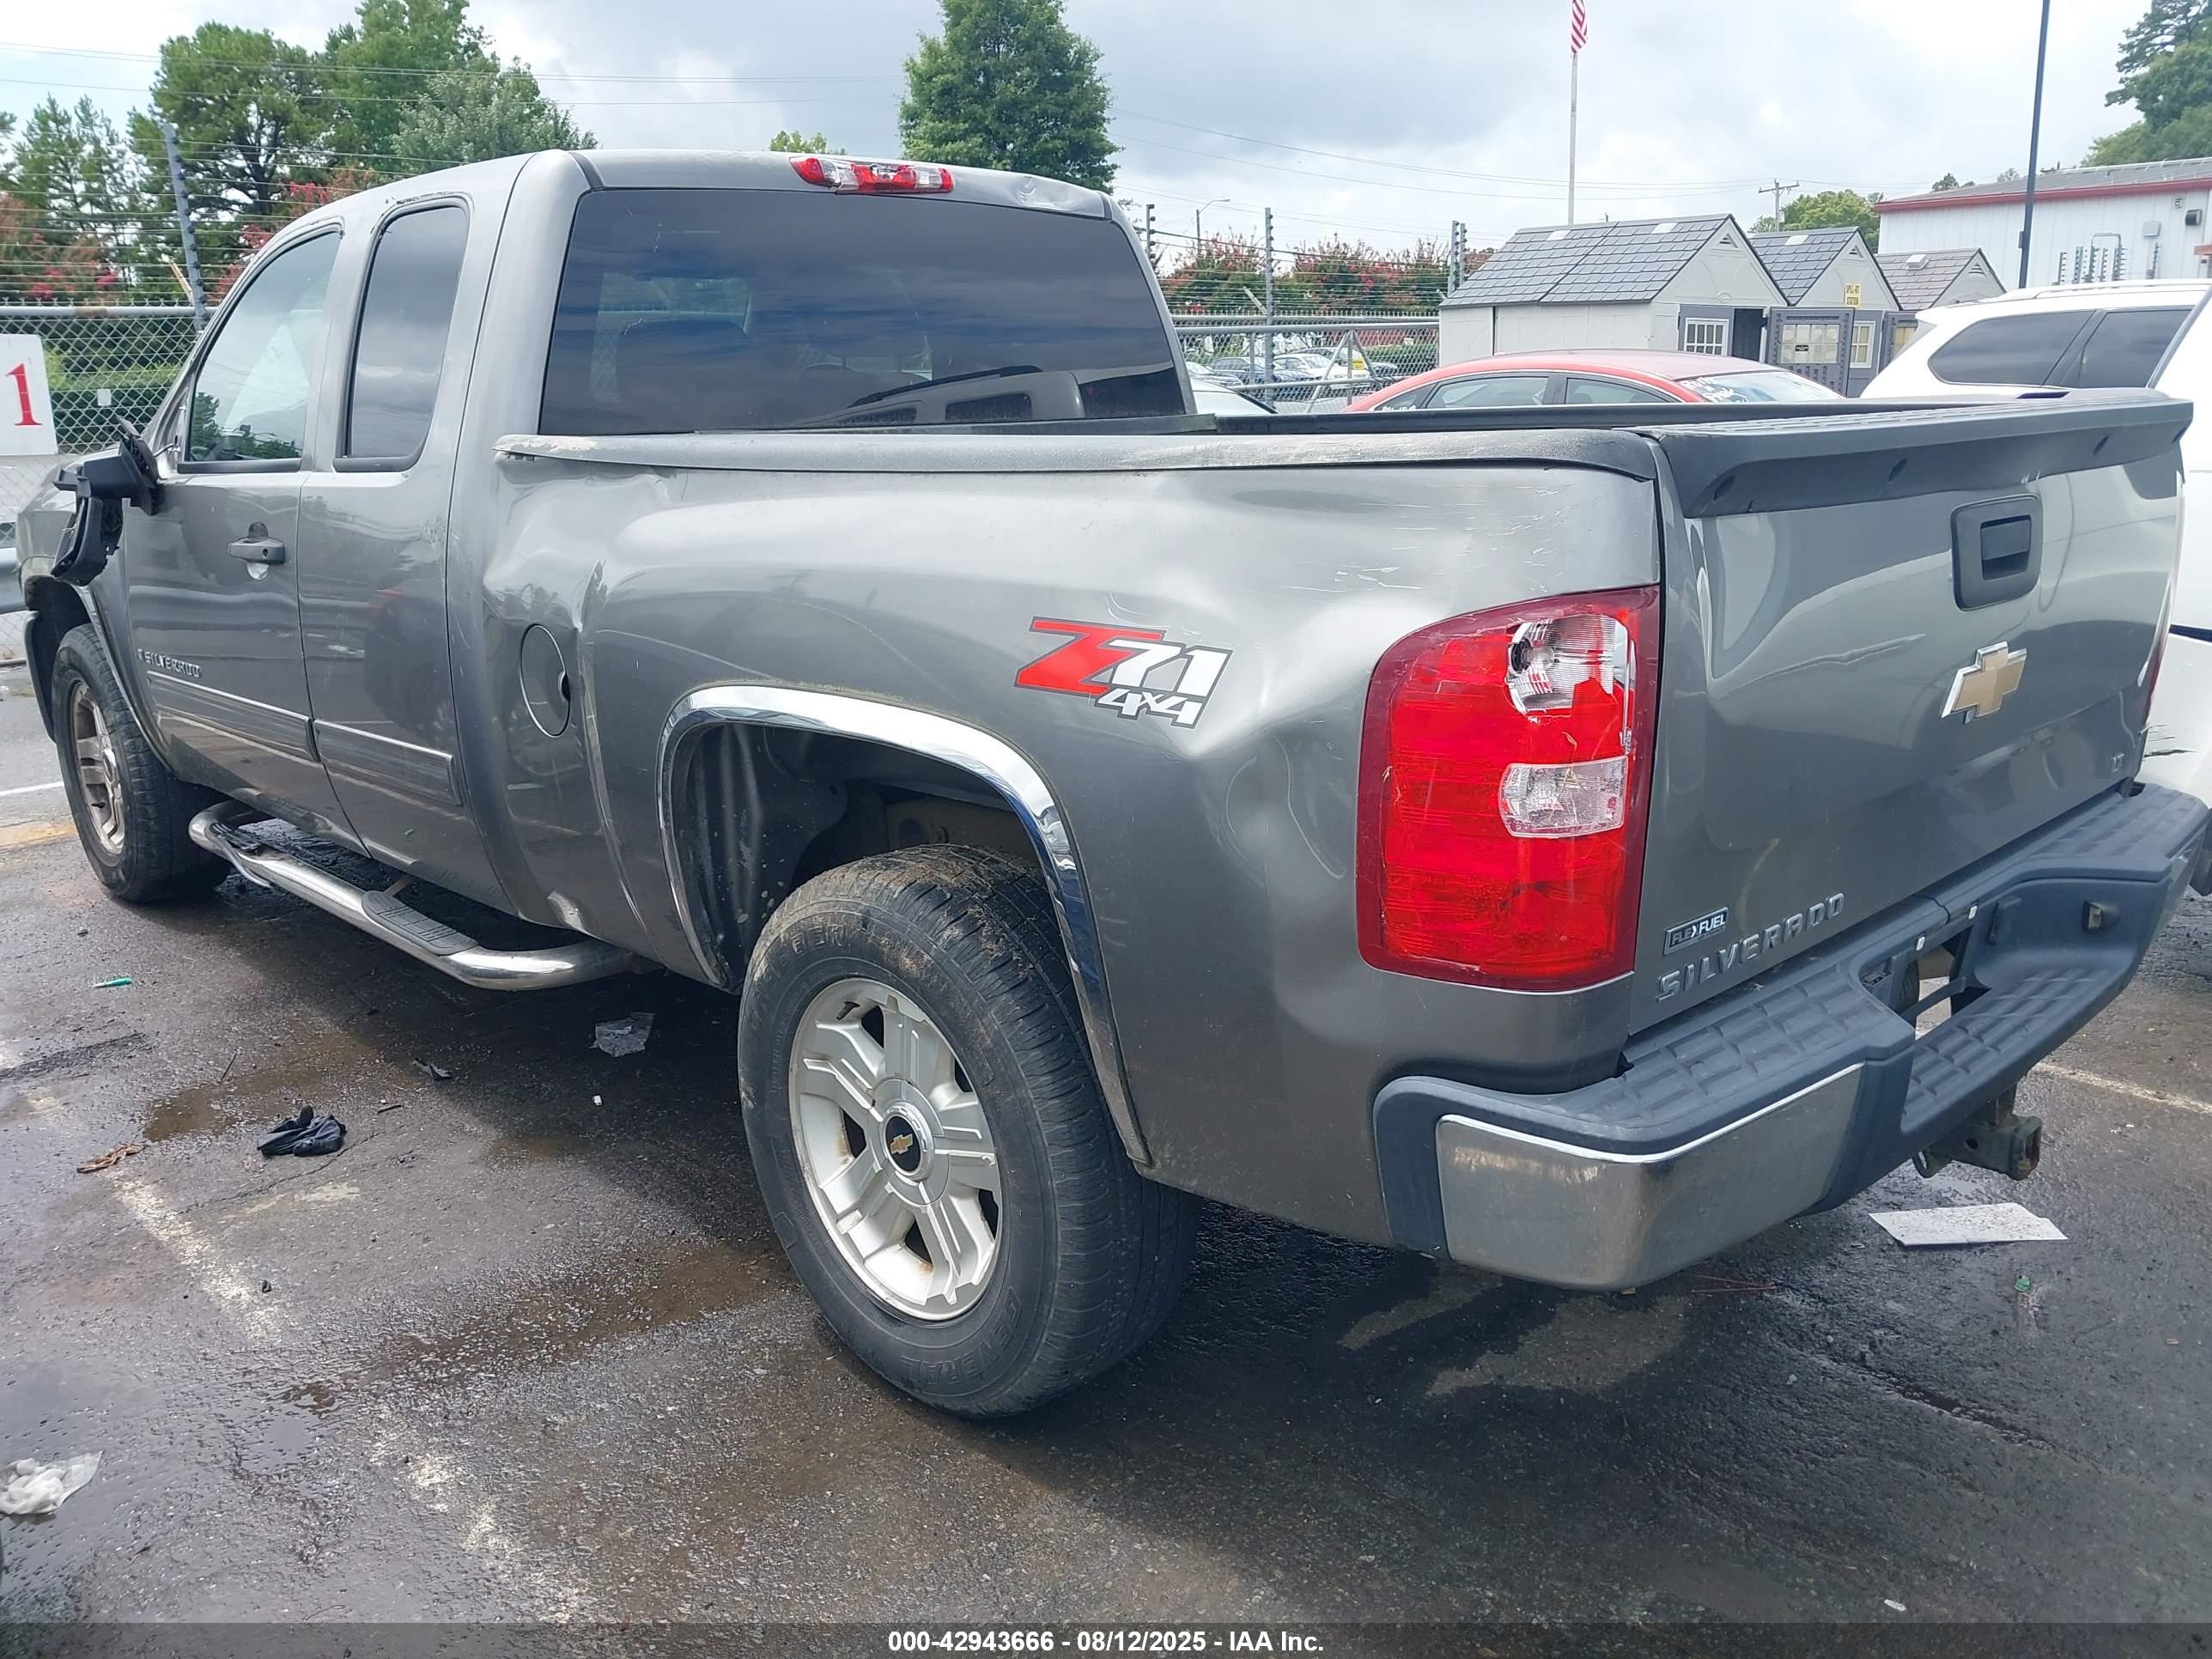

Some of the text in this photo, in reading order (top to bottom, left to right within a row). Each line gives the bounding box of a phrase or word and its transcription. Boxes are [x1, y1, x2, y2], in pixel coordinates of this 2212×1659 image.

[7, 362, 42, 426] 1
[144, 650, 203, 678] SILVERADO
[1015, 617, 1234, 699] Z71
[1656, 892, 1845, 1003] SILVERADO
